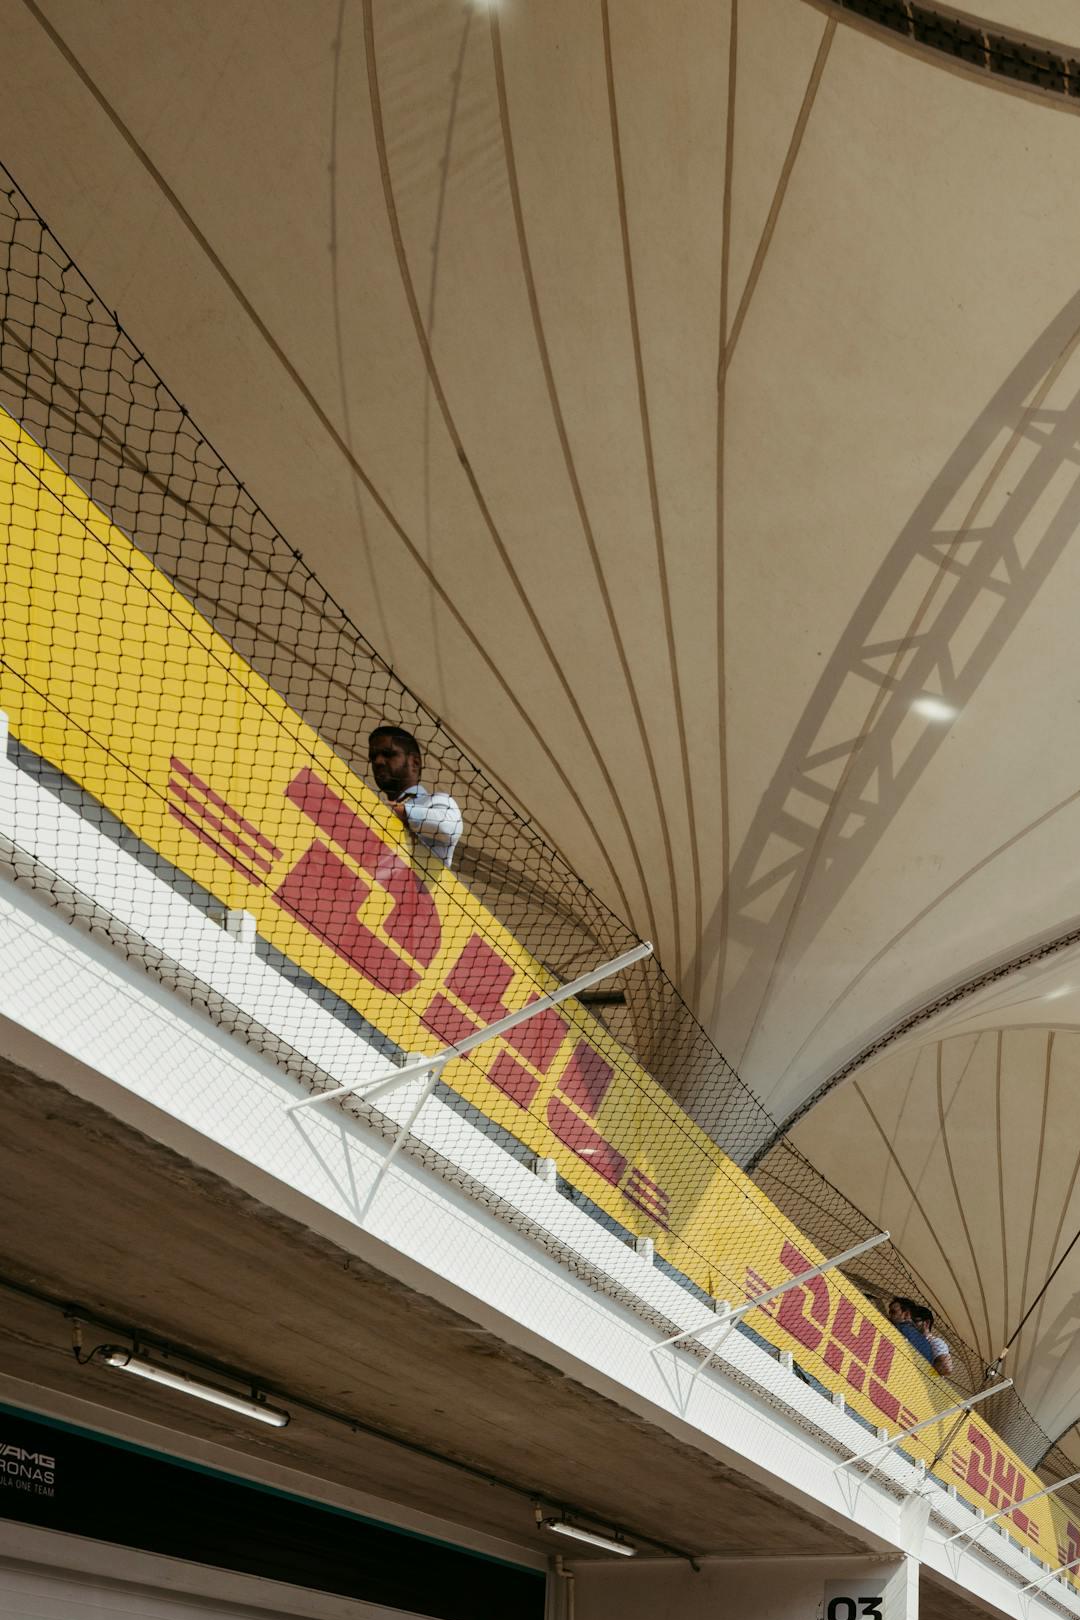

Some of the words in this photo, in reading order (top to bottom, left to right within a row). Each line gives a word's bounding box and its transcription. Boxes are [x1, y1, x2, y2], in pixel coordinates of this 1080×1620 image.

[271, 766, 628, 1188] DHL
[776, 1240, 901, 1423] DHL
[2, 1445, 56, 1469] AMG
[966, 1423, 1030, 1536] DHL
